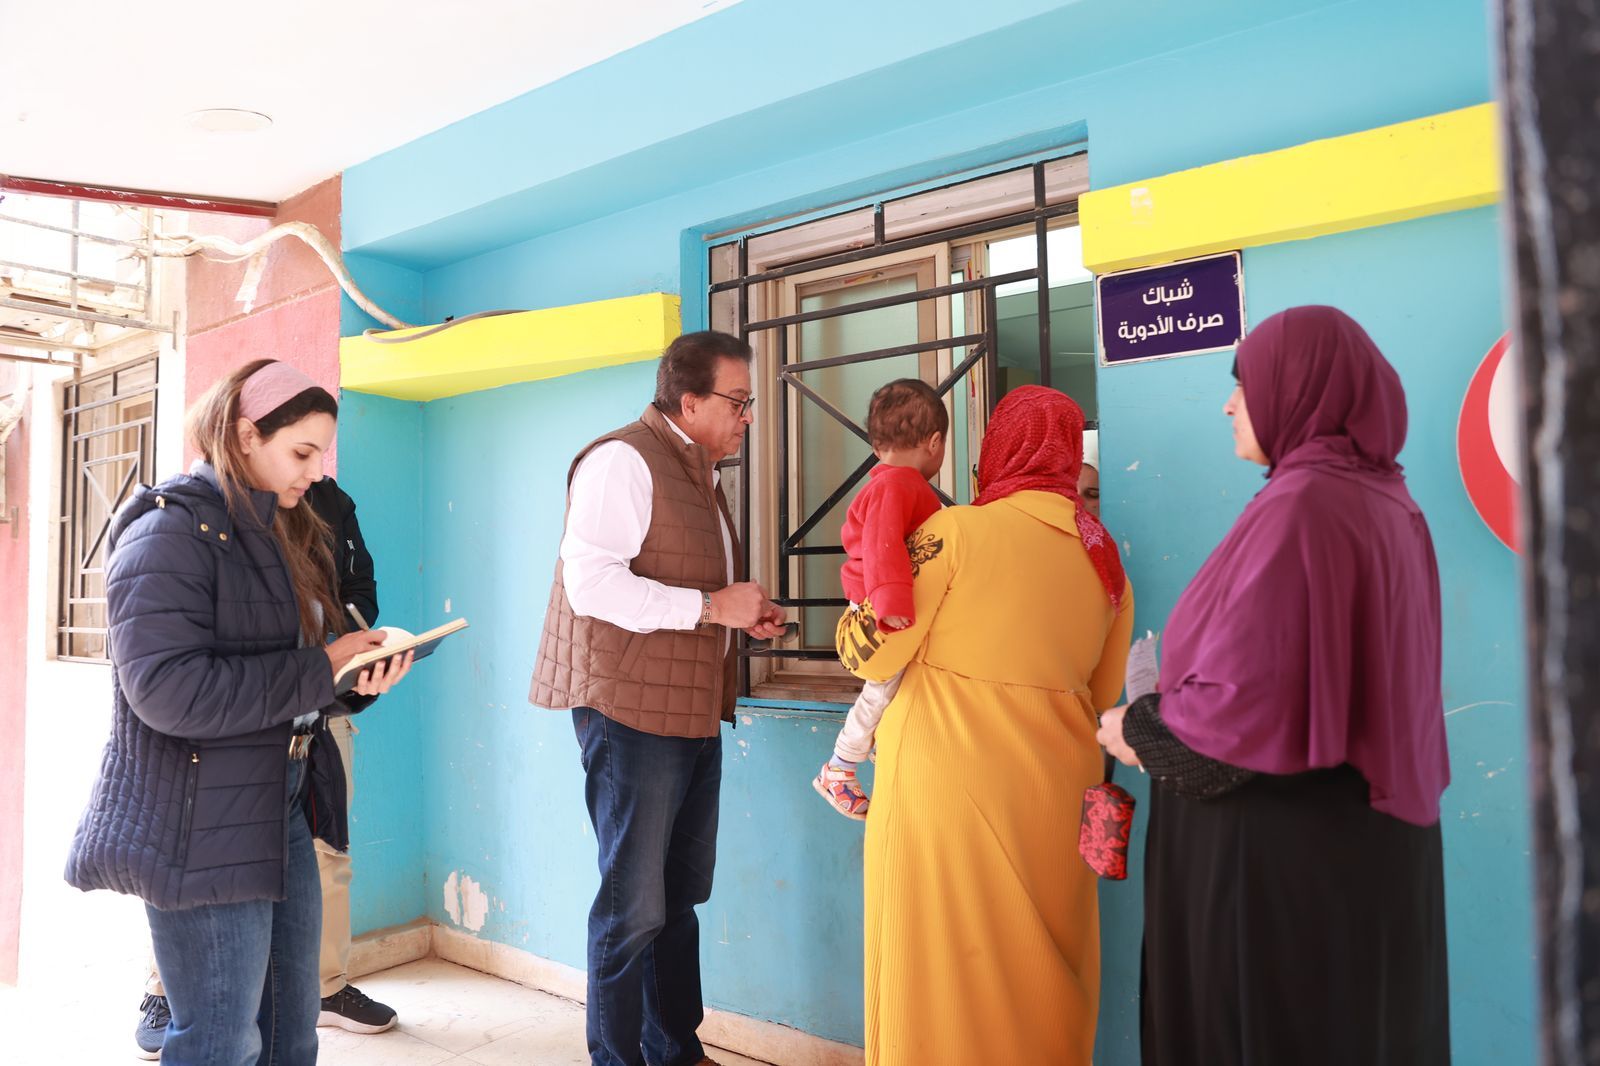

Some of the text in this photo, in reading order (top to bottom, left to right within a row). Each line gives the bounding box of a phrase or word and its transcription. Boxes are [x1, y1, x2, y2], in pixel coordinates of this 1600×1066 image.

[1142, 278, 1194, 306] شباك
[1118, 312, 1224, 344] صرف الأدوية
